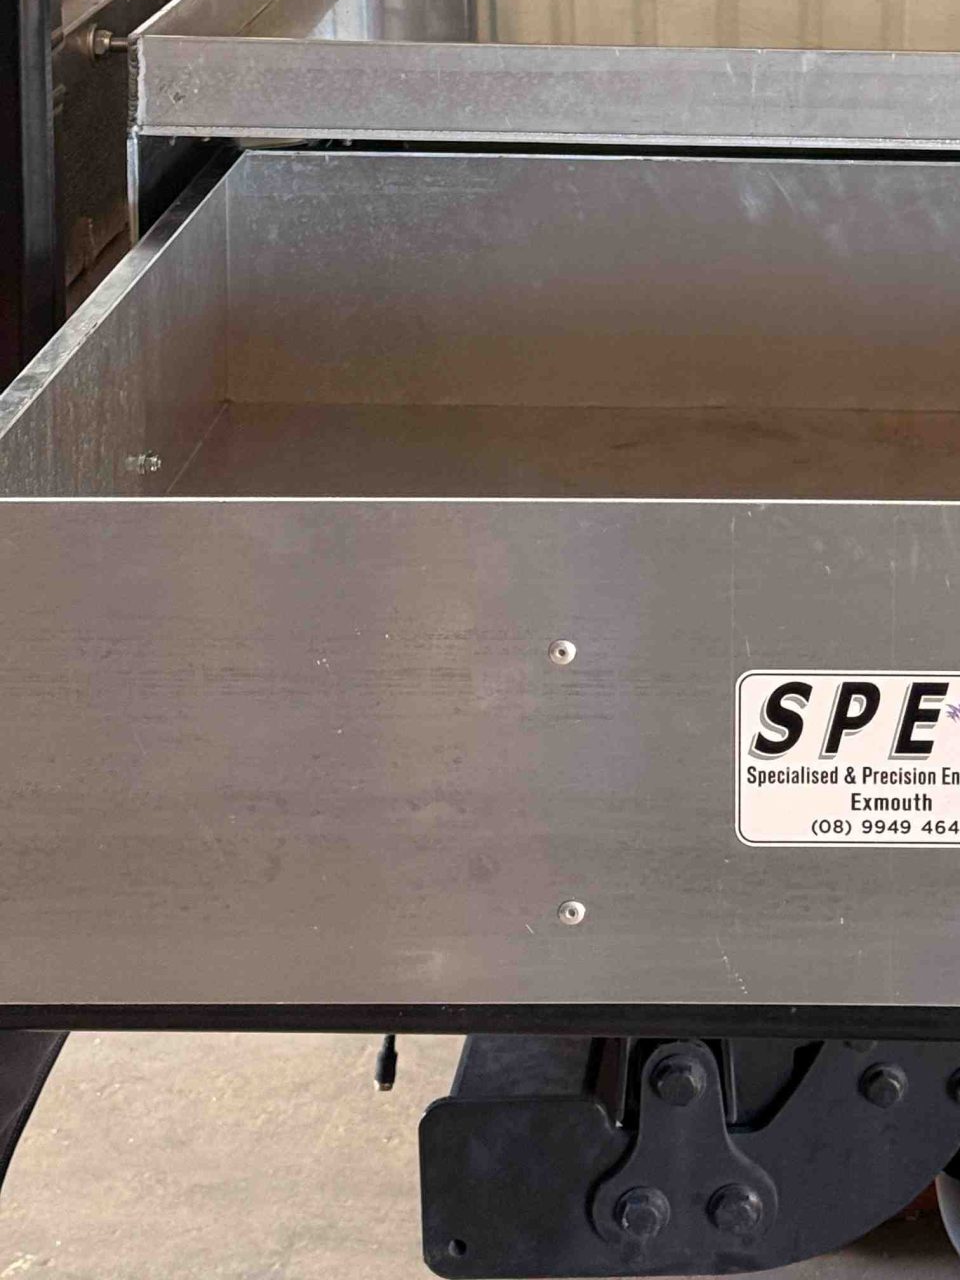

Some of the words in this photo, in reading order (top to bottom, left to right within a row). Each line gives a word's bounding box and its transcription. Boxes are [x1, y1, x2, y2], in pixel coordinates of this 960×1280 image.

[748, 681, 950, 761] SPE
[747, 766, 838, 787] Specialised
[844, 767, 857, 785] &
[862, 767, 936, 785] Precision
[851, 792, 933, 812] Exmouth
[811, 819, 852, 836] (08)
[862, 820, 912, 835] 9949
